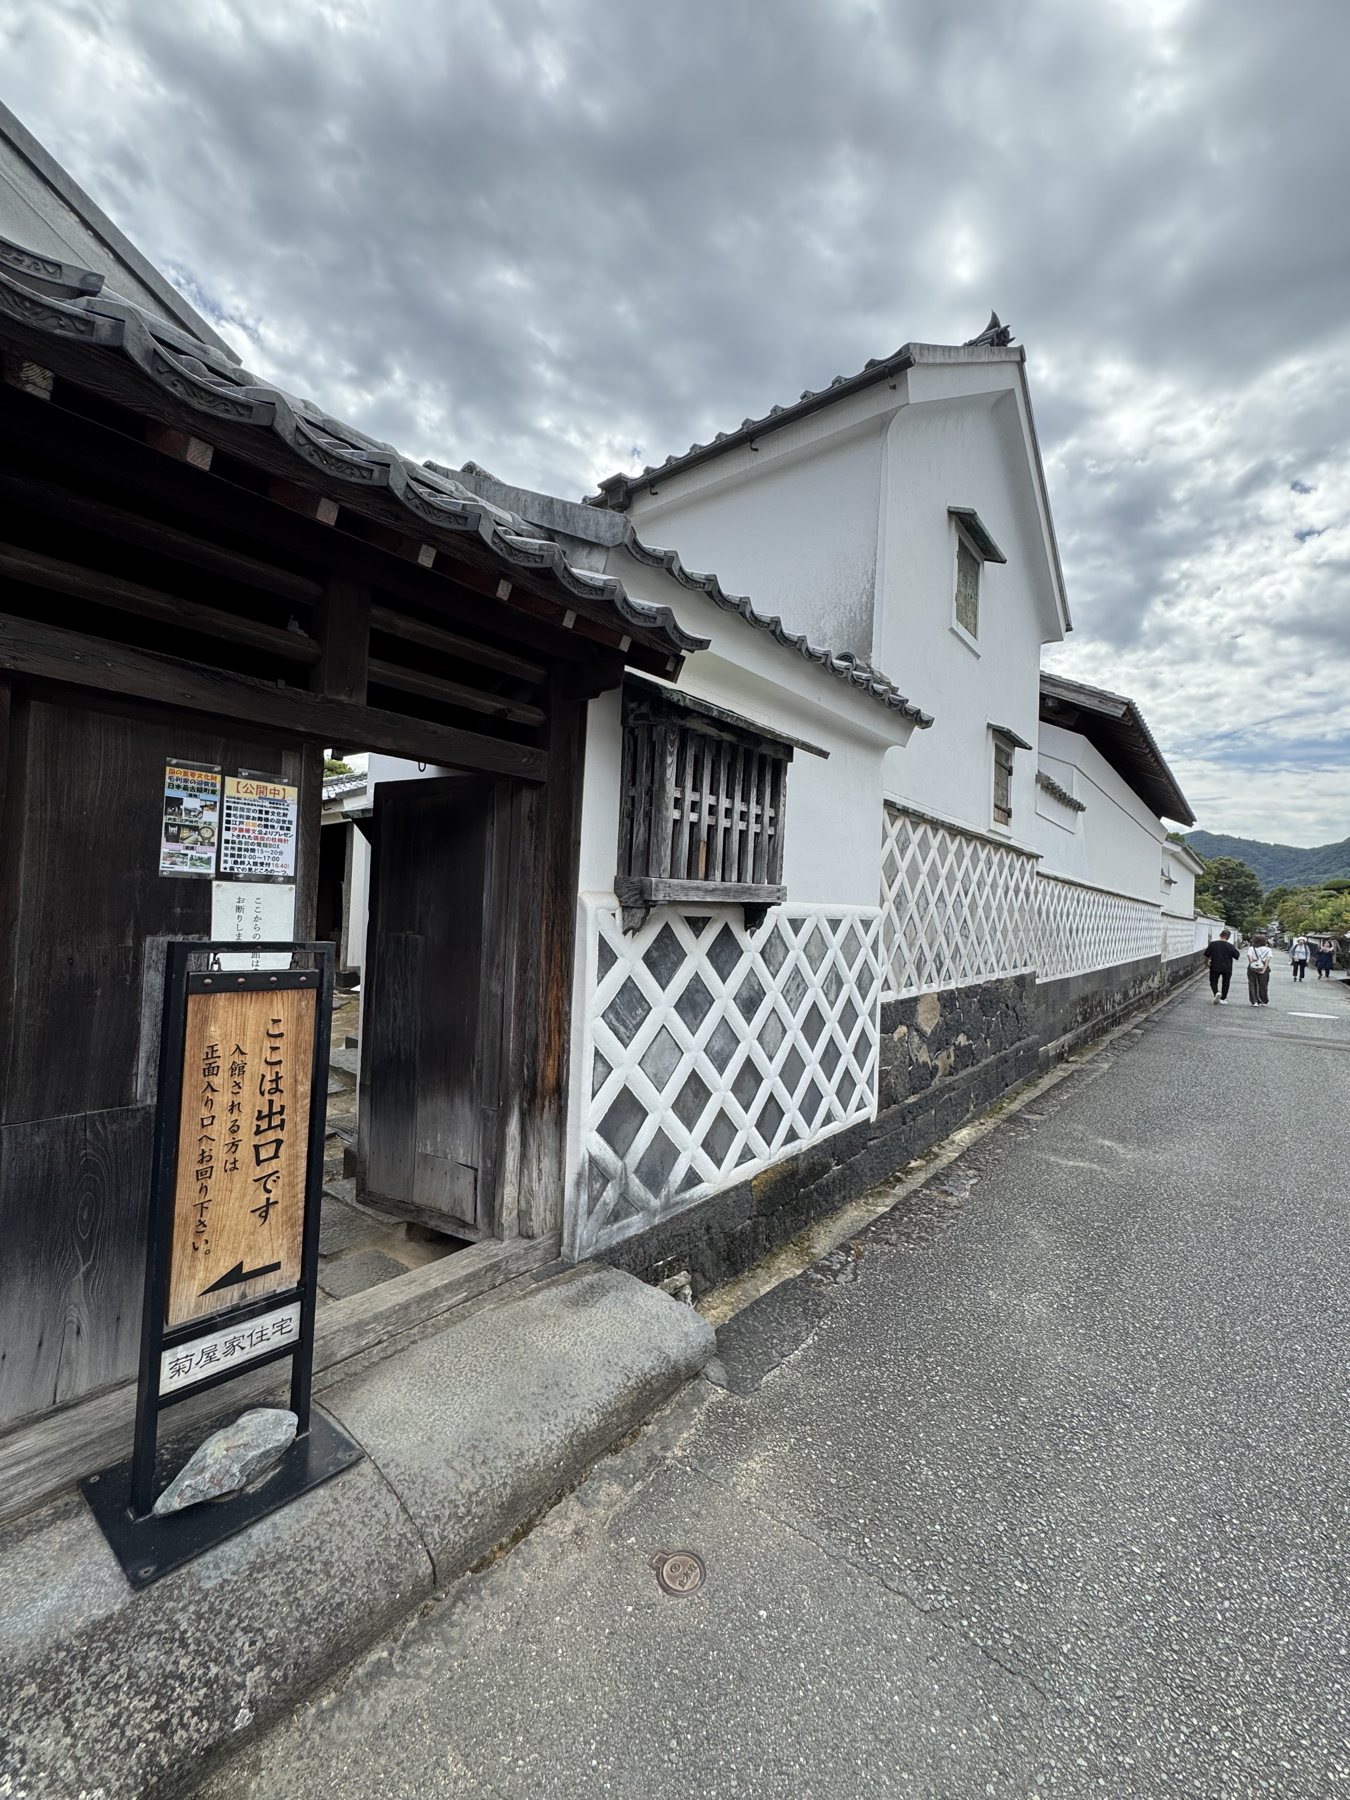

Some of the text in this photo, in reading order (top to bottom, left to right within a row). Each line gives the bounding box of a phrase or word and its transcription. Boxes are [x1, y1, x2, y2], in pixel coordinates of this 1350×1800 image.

[235, 896, 246, 941] お断りしま
[192, 1043, 222, 1255] 正面入り口へお回り下さい。
[223, 1043, 248, 1173] 入館される方は
[250, 1018, 286, 1227] ここは出口です
[168, 1317, 293, 1379] 菊屋家住宅
